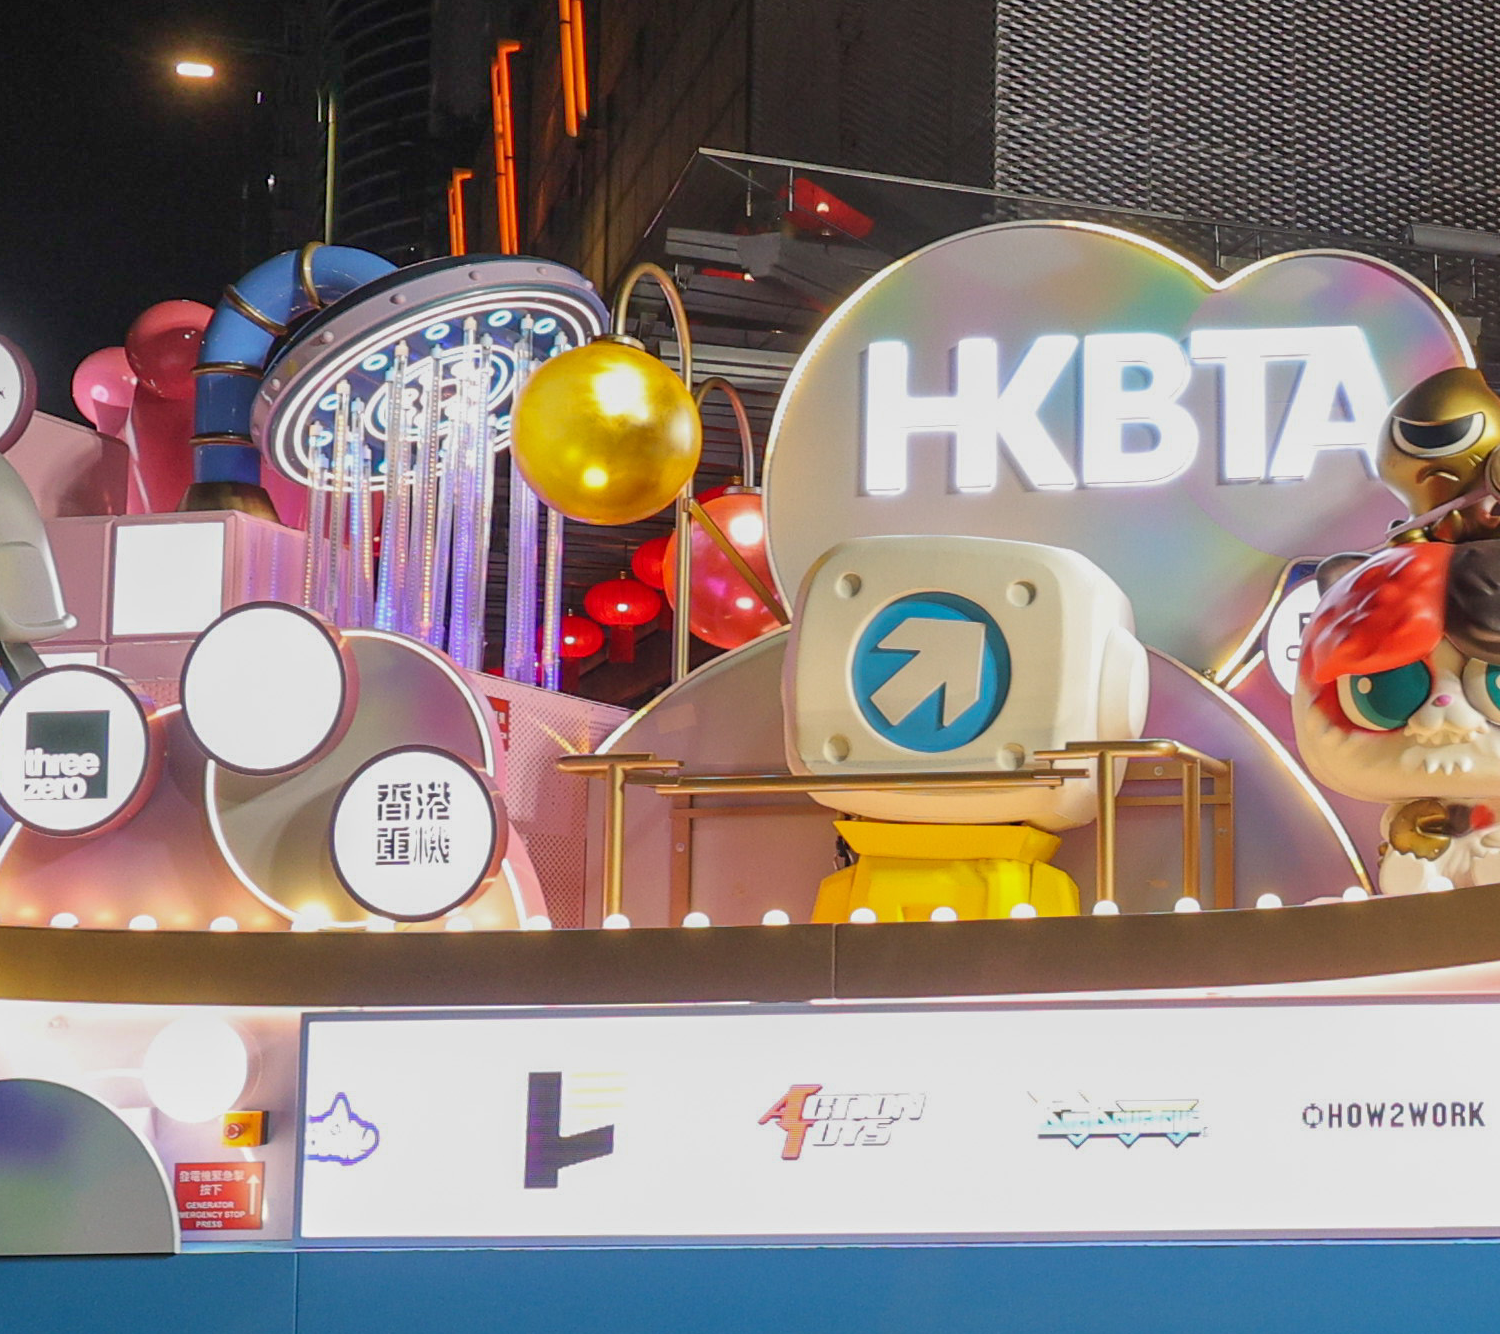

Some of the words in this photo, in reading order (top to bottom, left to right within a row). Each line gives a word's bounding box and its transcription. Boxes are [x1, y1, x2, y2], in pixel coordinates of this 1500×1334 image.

[864, 325, 1390, 496] HKBTA
[25, 747, 100, 777] three
[24, 776, 87, 800] zero
[377, 782, 451, 821] 香港
[1328, 1101, 1486, 1128] HOW2WORK
[178, 1211, 222, 1219] MERGENCY
[224, 1210, 246, 1218] STOP
